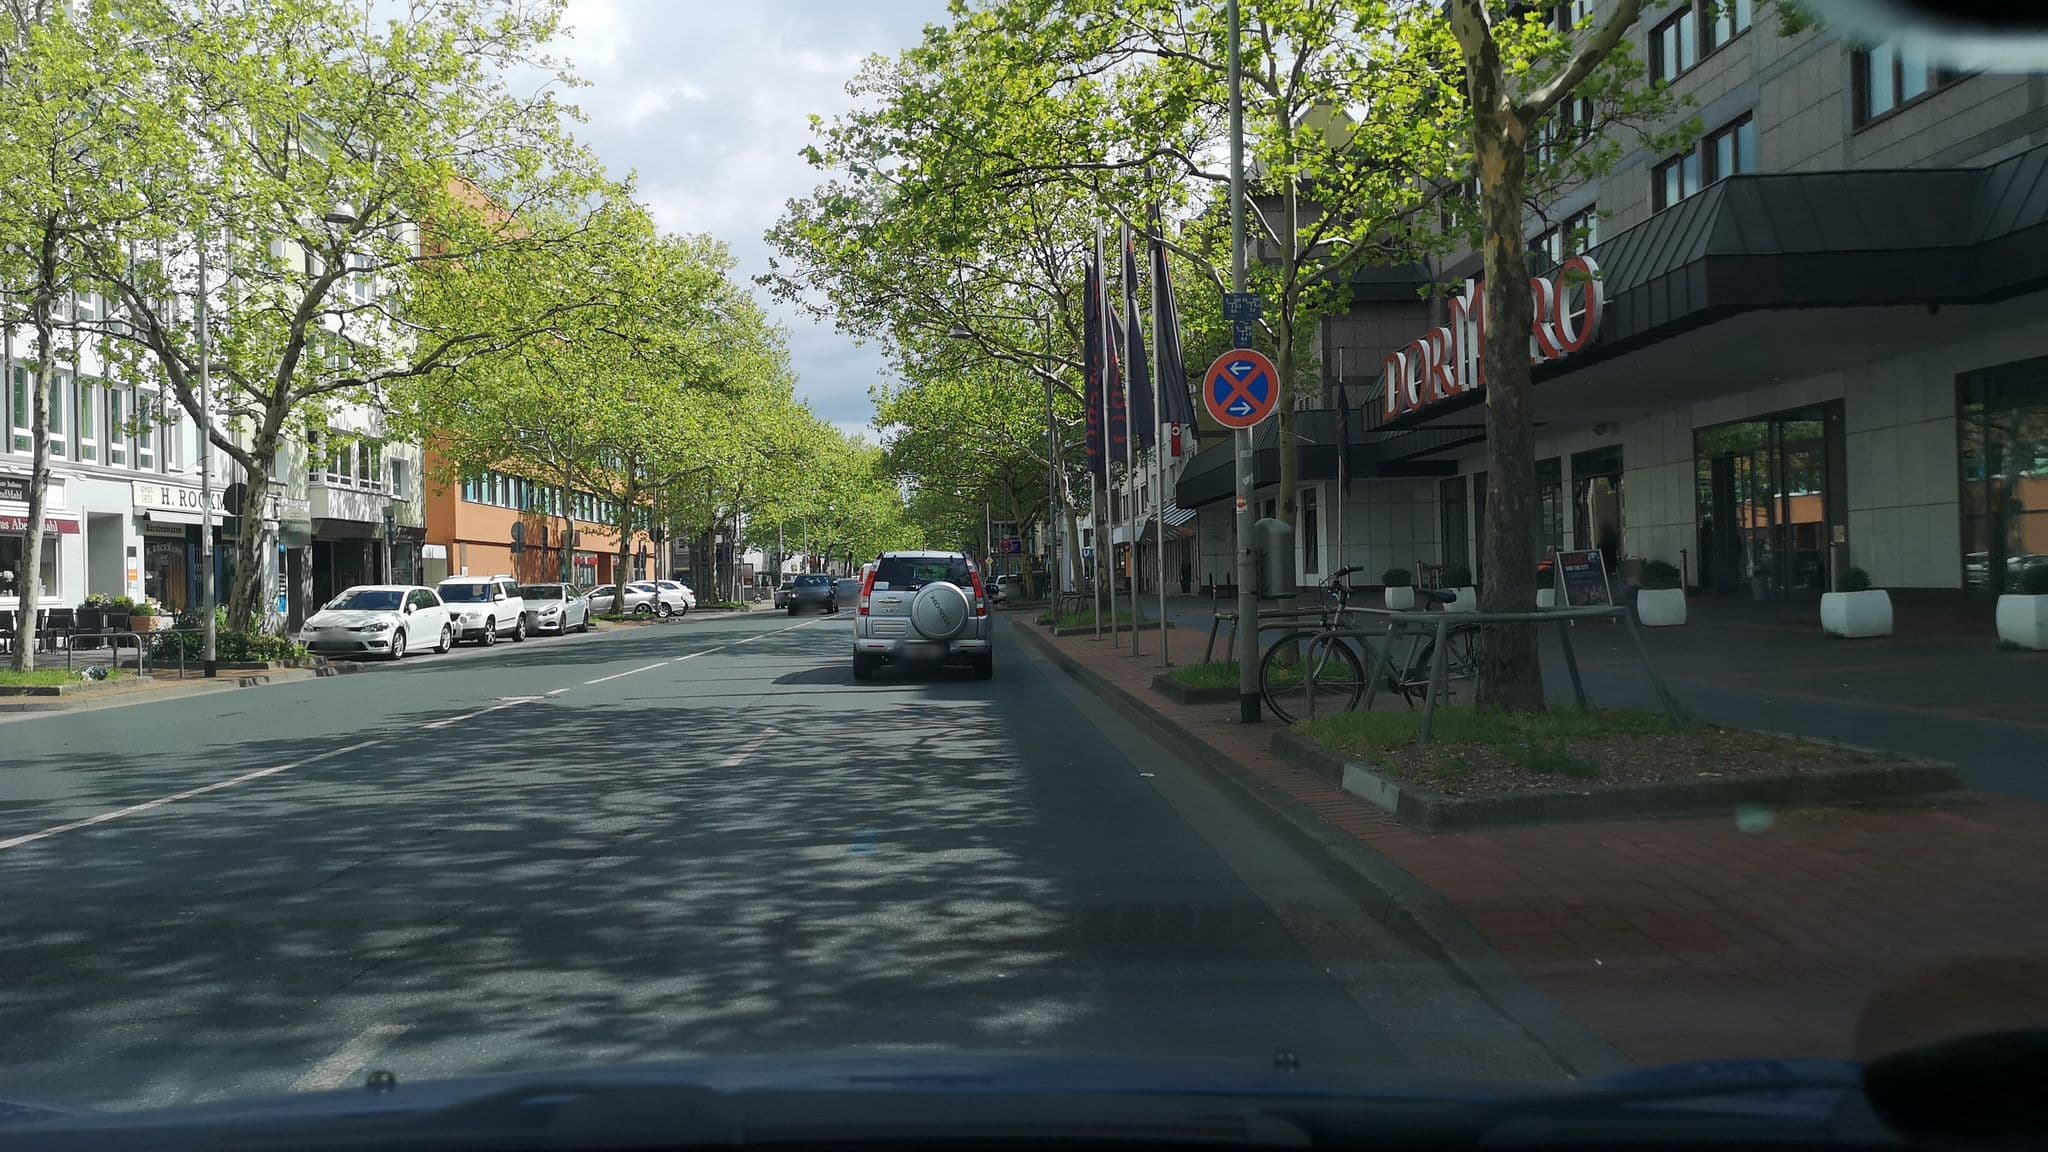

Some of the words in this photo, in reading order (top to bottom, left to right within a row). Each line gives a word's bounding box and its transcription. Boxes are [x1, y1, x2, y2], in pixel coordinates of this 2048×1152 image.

[1383, 255, 1604, 424] DORMRO
[12, 518, 58, 532] Abeahl
[930, 595, 953, 627] HONDA
